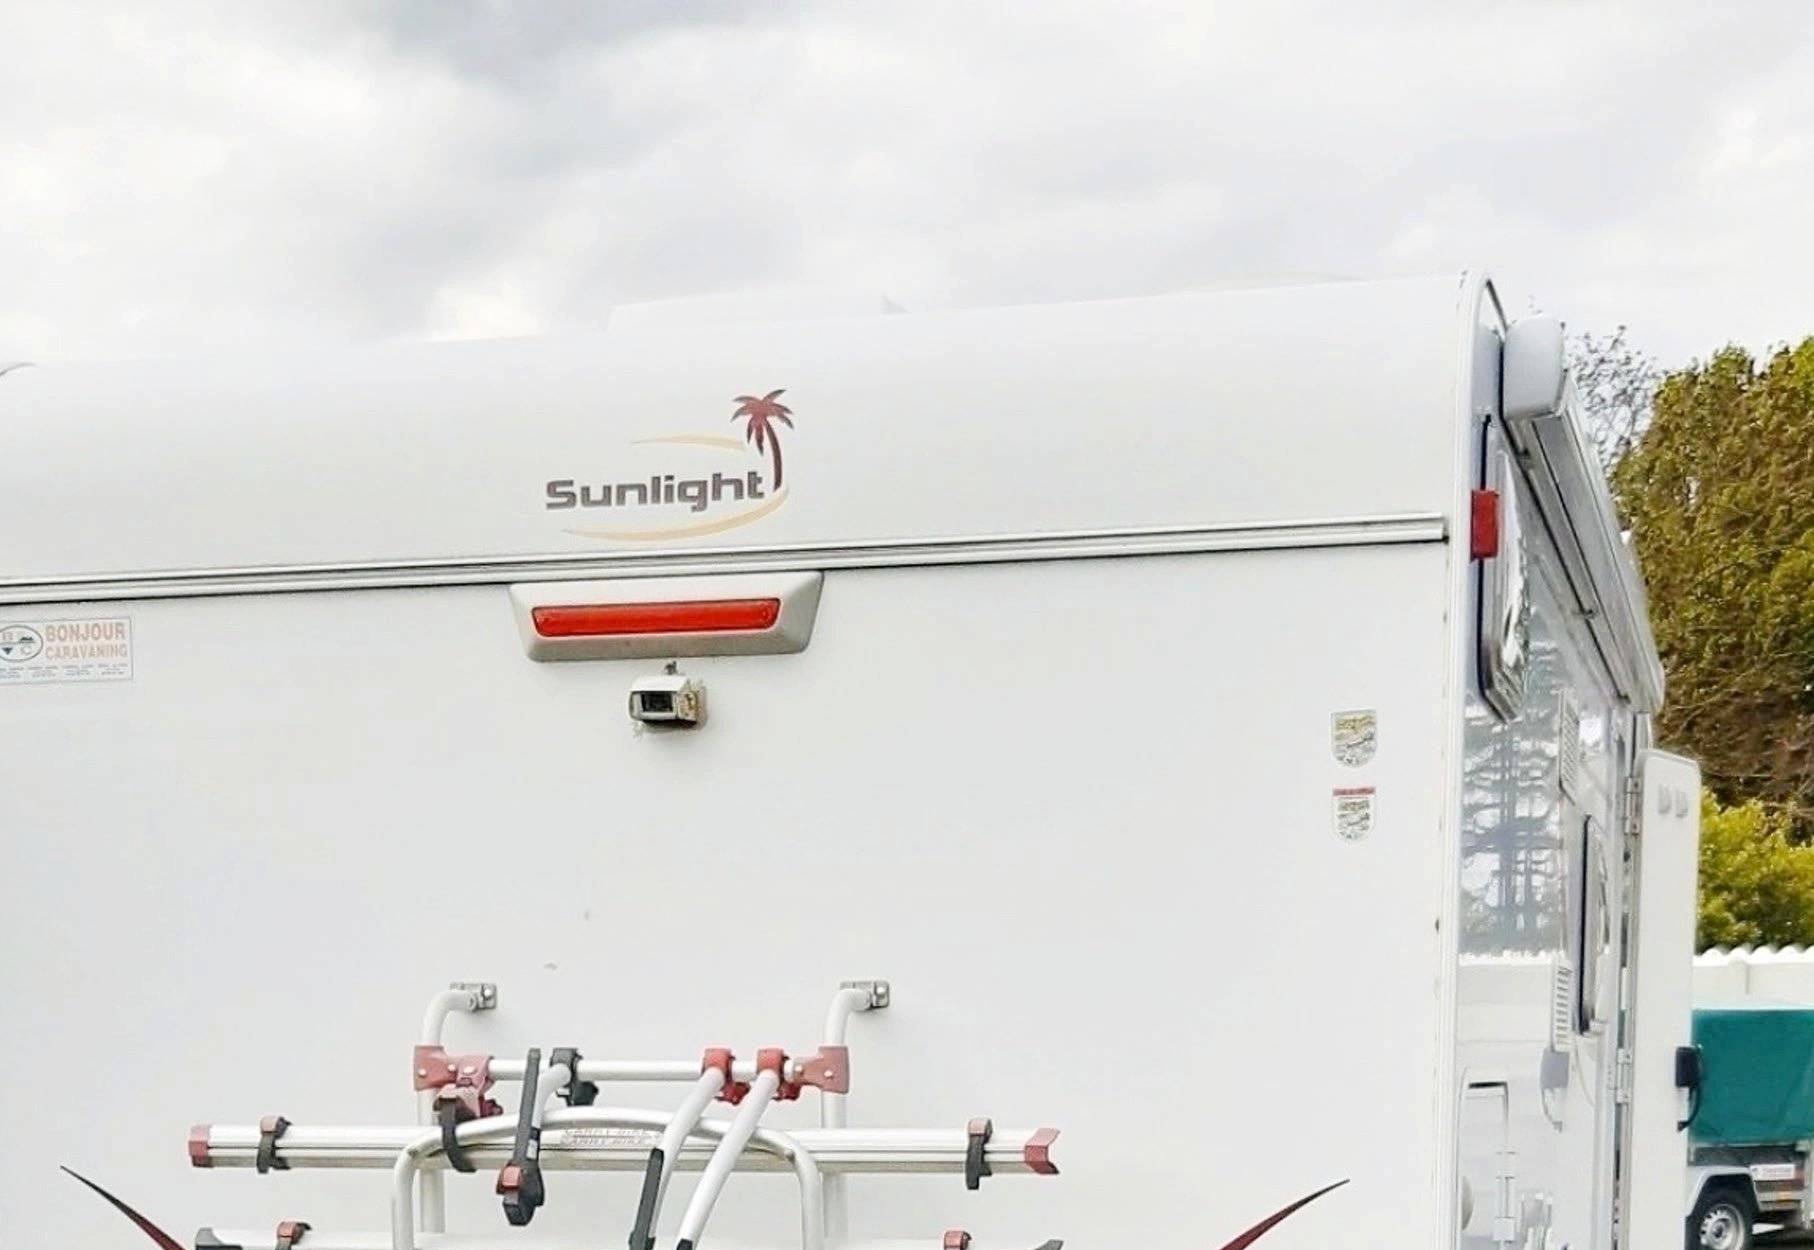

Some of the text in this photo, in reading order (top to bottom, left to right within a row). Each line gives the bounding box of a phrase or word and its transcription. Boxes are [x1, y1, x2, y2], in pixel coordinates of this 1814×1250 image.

[546, 471, 765, 512] Sunlight
[46, 622, 126, 642] BONJOUR
[45, 643, 128, 660] CARAVANING
